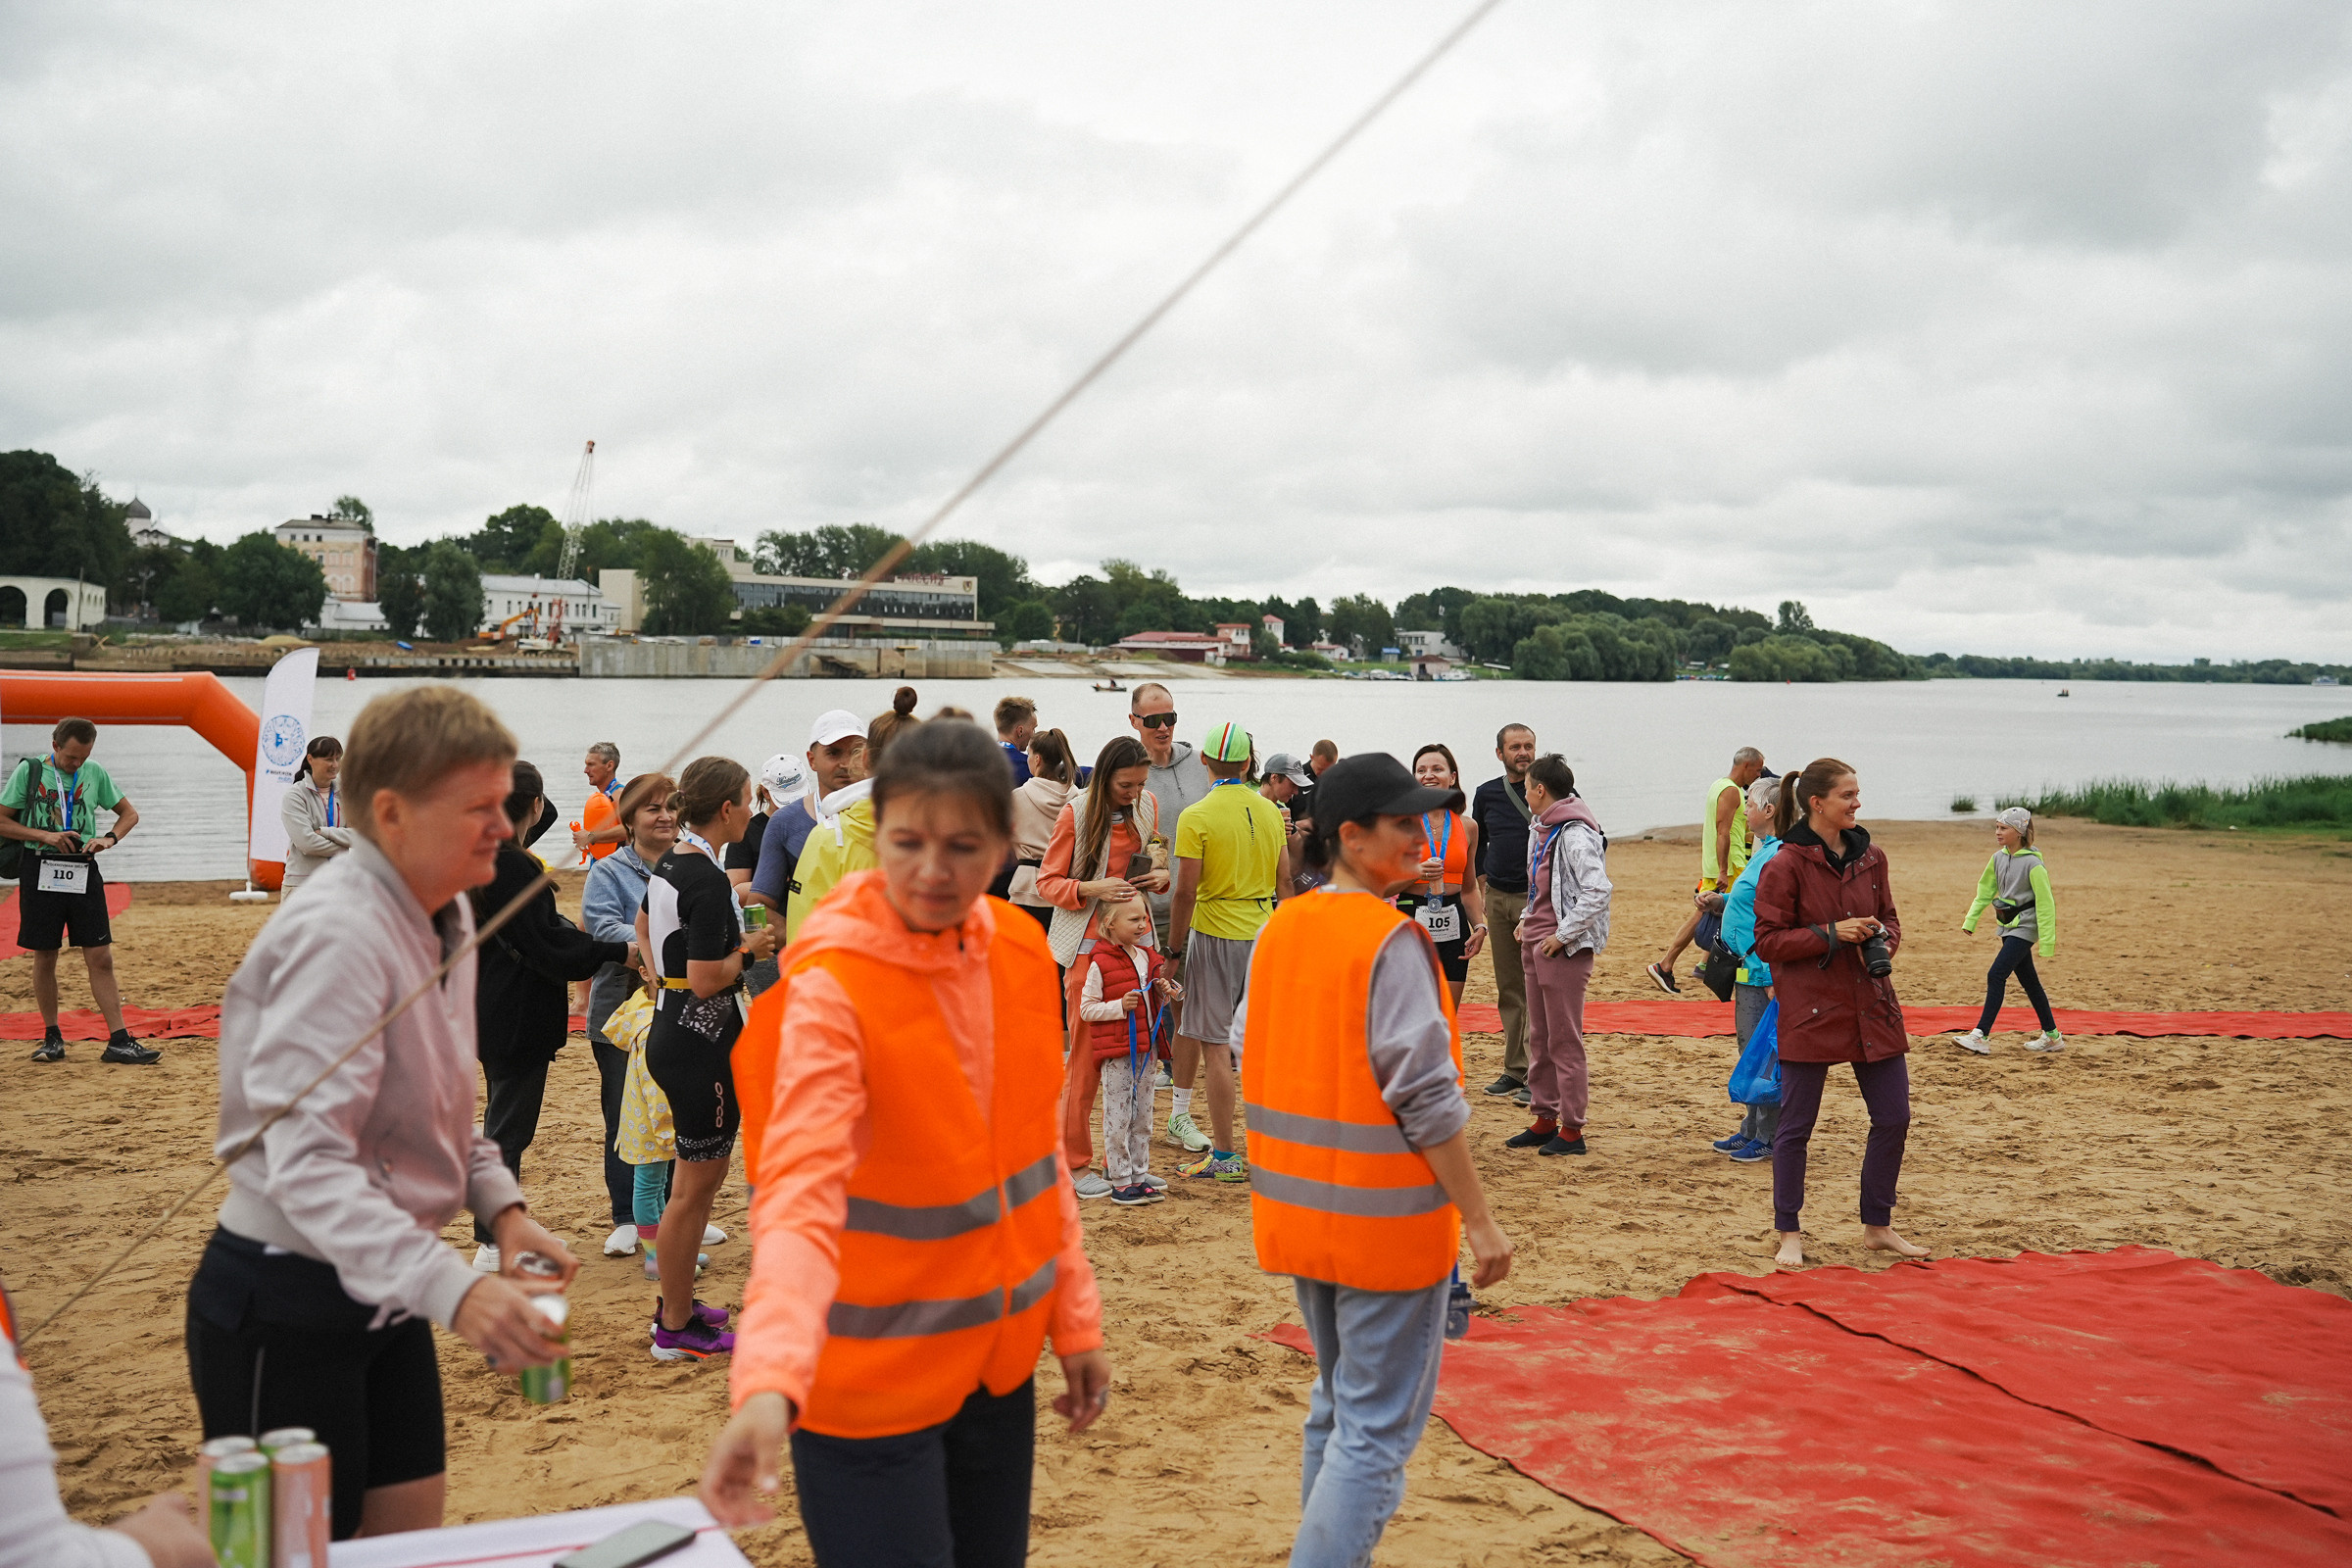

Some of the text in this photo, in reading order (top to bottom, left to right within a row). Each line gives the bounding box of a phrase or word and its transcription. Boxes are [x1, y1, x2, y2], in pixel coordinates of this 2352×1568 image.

[53, 869, 74, 880] 110
[1428, 916, 1450, 929] 105
[714, 1082, 724, 1128] orca
